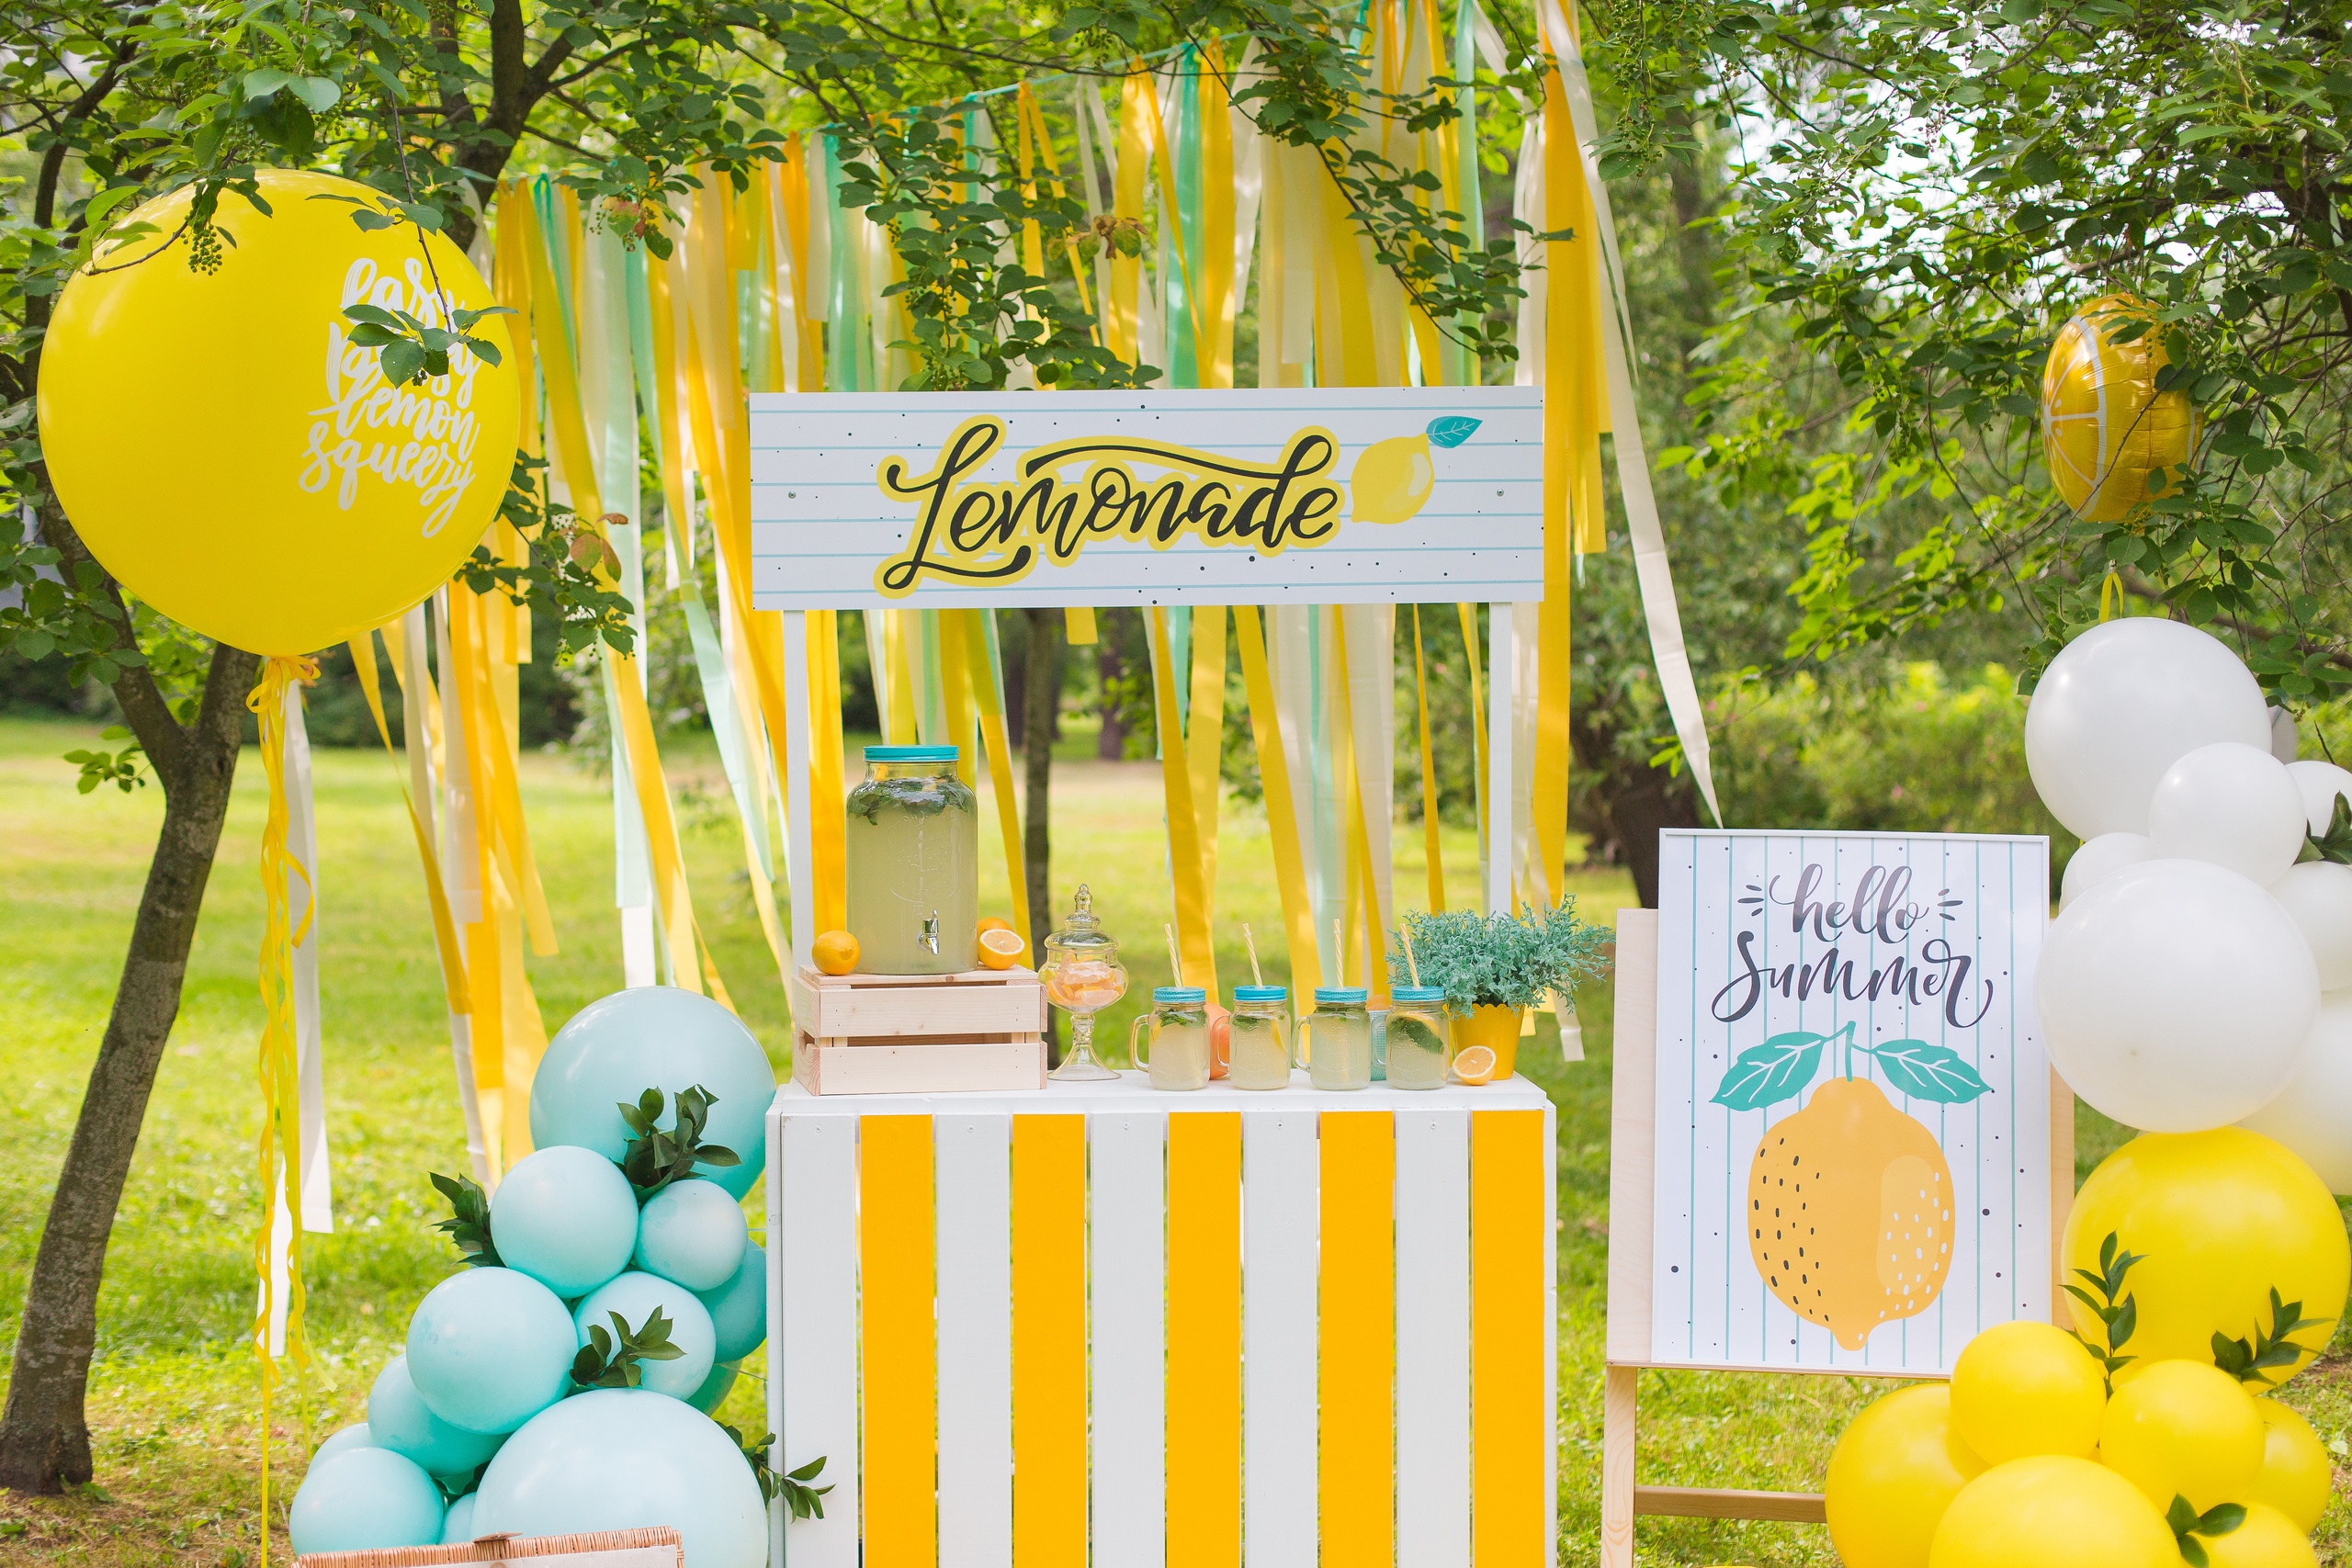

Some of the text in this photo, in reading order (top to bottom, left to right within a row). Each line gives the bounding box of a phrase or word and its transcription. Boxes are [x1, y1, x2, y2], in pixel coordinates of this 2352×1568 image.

[307, 360, 481, 464] lemon
[299, 421, 477, 539] squeezy
[883, 423, 1338, 591] Lemonade
[1769, 863, 1929, 944] hello
